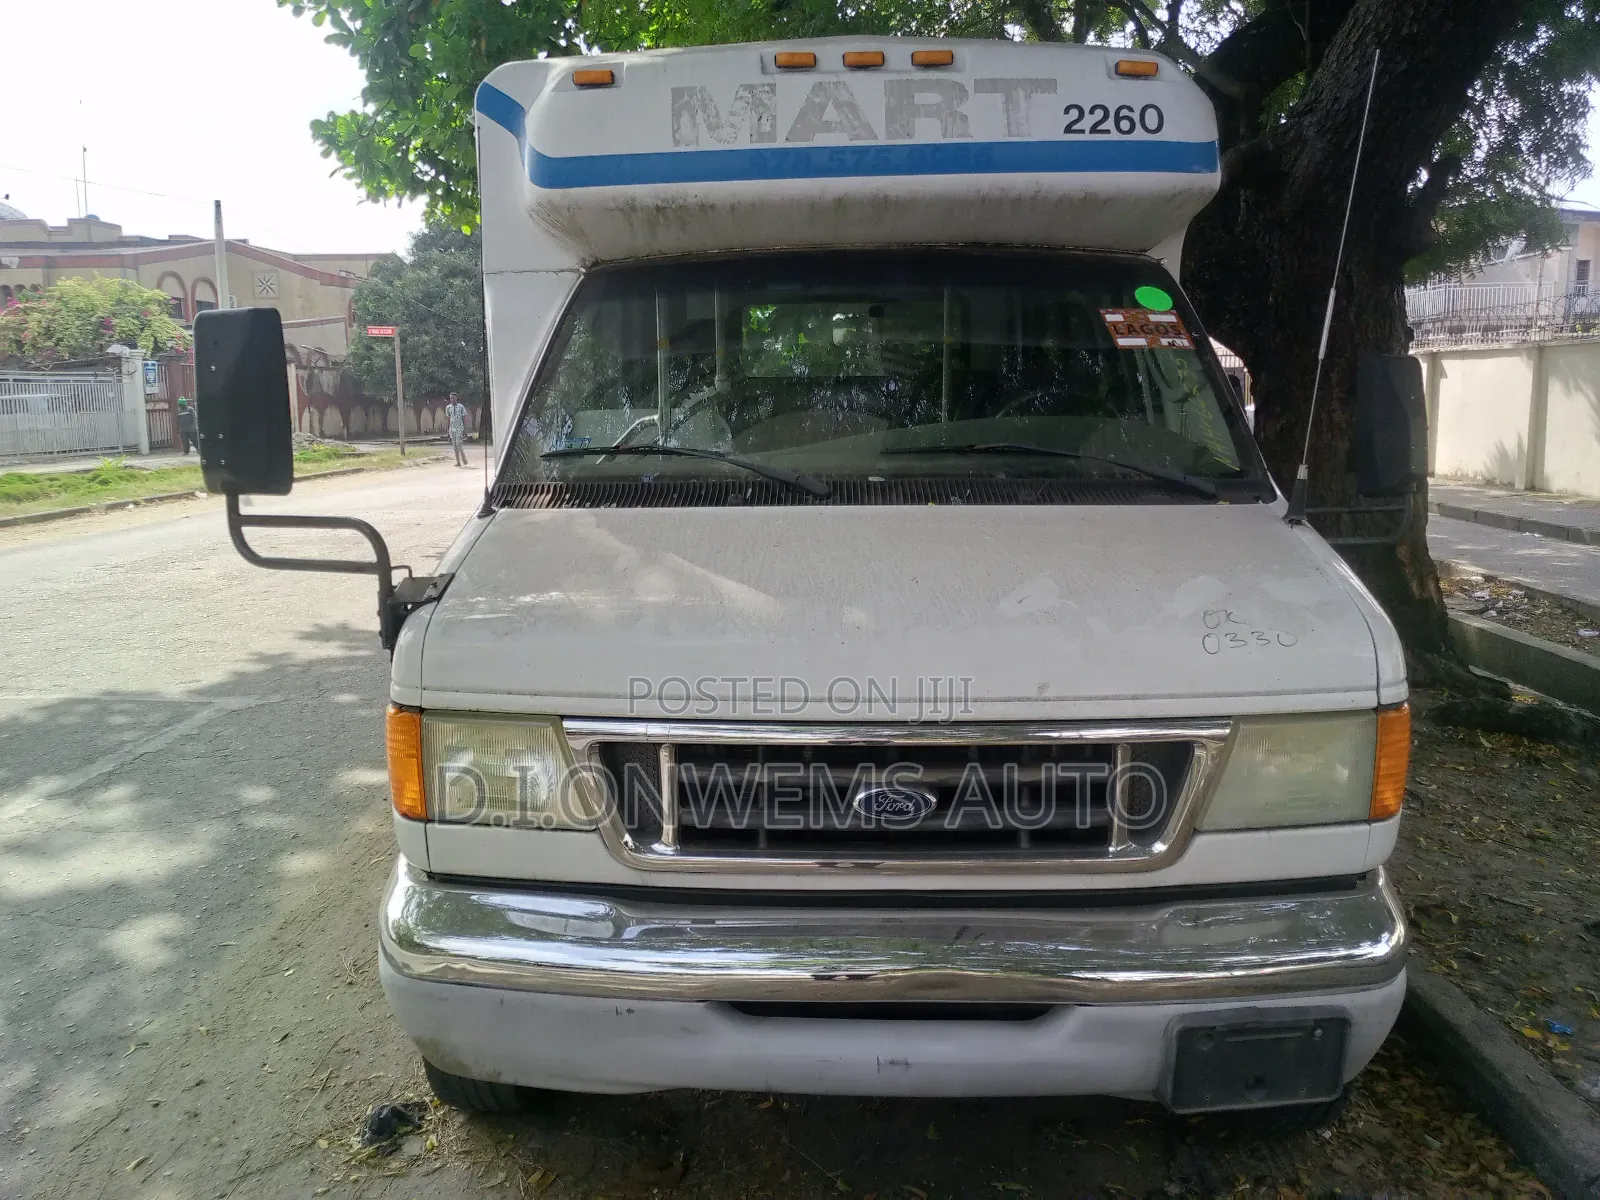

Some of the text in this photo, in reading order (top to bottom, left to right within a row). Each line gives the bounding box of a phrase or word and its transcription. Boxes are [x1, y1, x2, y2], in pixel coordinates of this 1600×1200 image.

[670, 77, 1058, 148] MART
[1062, 103, 1165, 135] 2260
[1112, 323, 1183, 336] LAGOS
[1202, 628, 1298, 655] 0330
[873, 794, 917, 814] Ford
